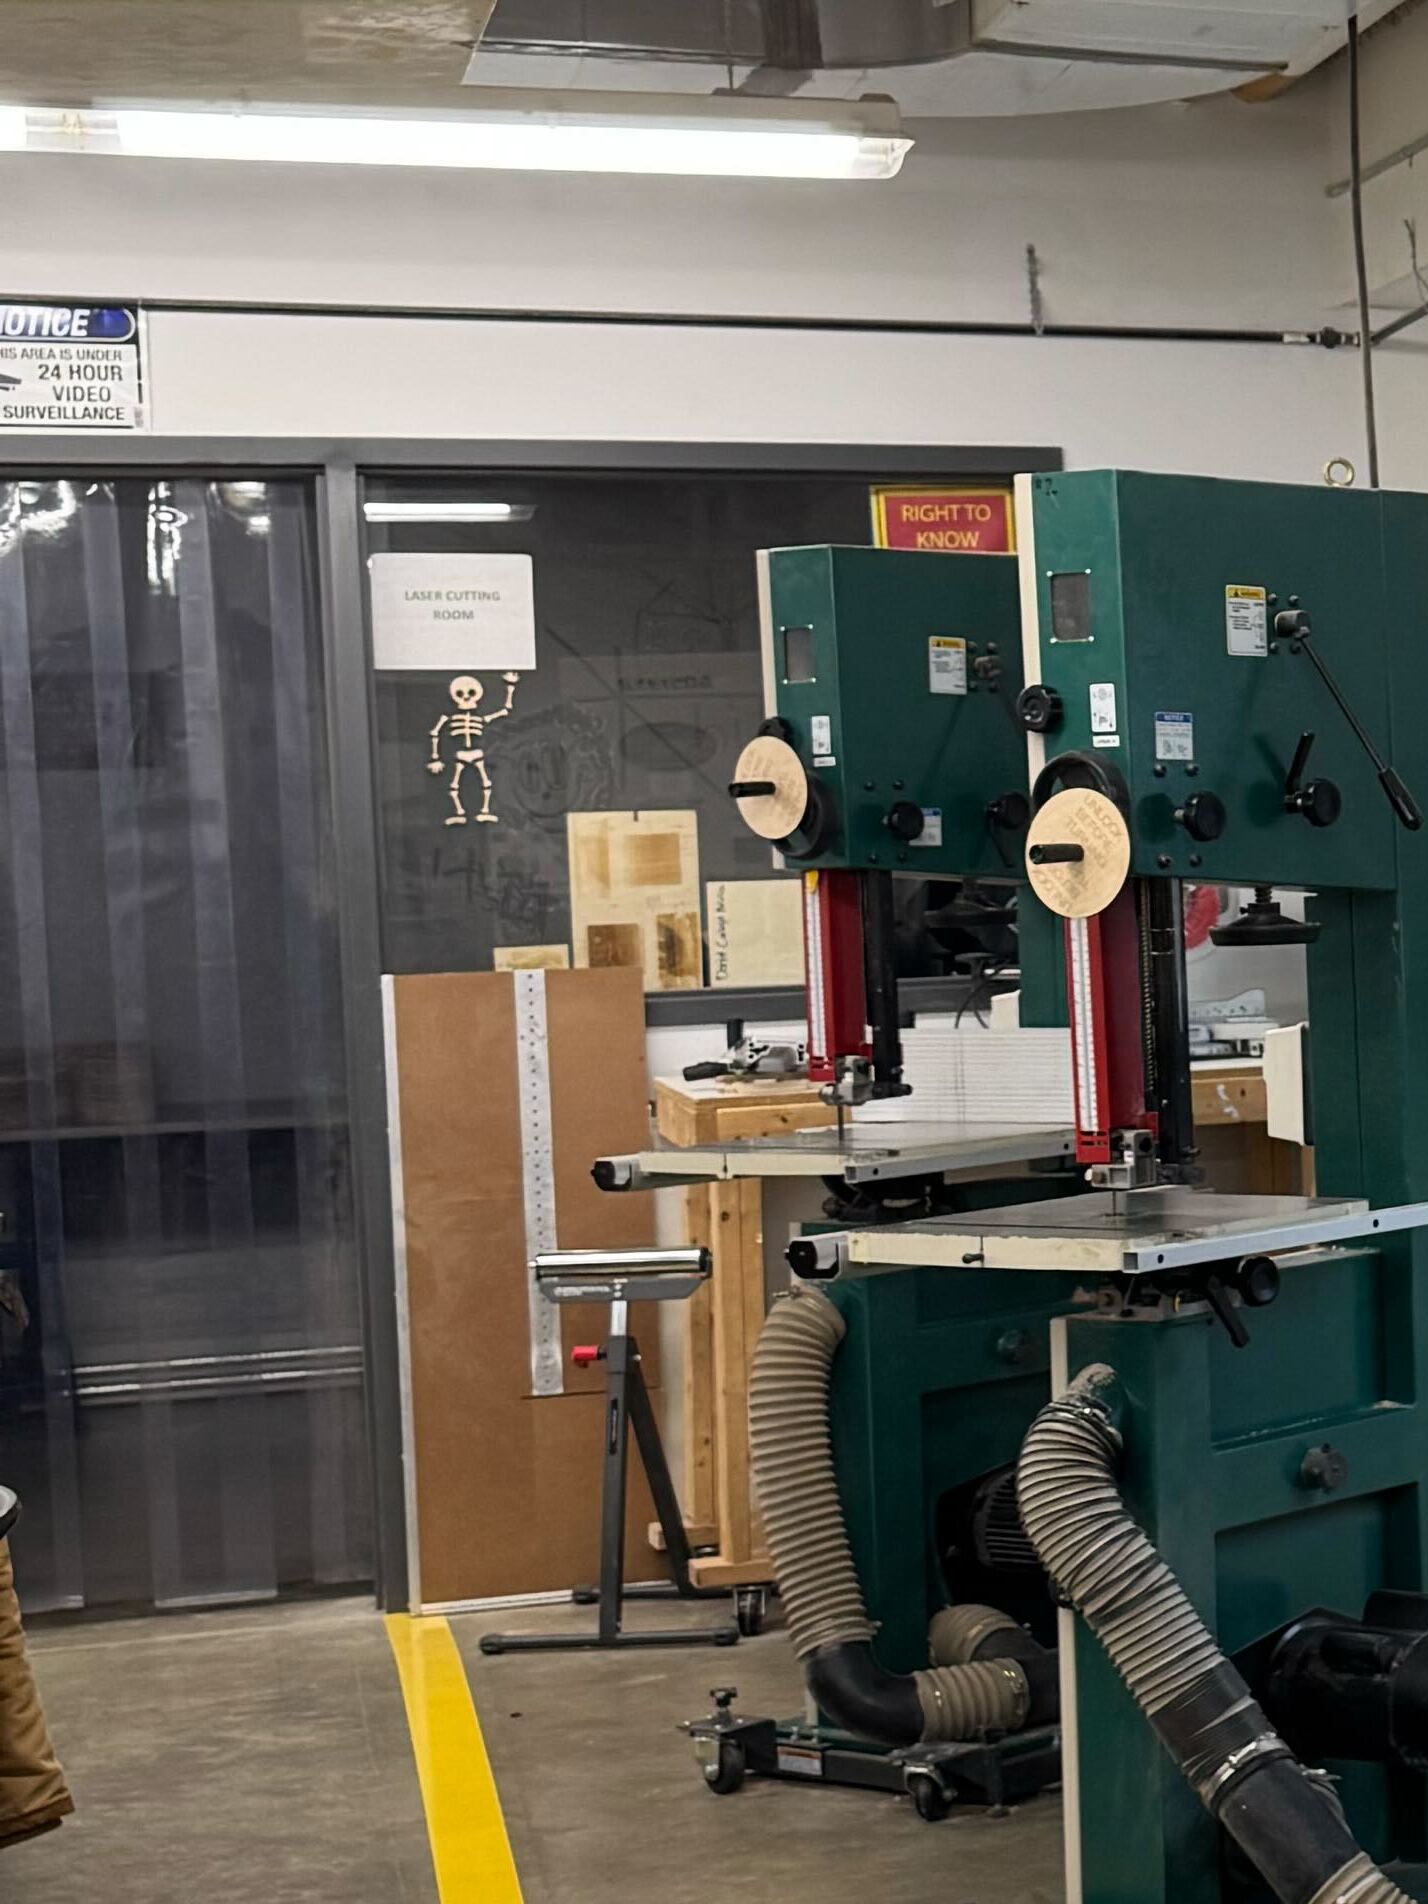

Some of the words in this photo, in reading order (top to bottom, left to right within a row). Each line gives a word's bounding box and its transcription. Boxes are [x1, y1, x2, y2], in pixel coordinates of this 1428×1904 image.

[20, 348, 57, 360] AREA
[60, 348, 73, 361] IS
[76, 348, 123, 362] UNDER
[38, 364, 61, 381] 24
[68, 364, 123, 382] HOUR
[53, 385, 112, 403] VIDEO
[3, 405, 125, 421] SURVEILLANCE
[902, 504, 960, 523] RIGHT
[961, 504, 992, 523] TO
[916, 530, 980, 549] KNOW
[404, 590, 443, 602] LASER
[445, 590, 501, 602] CUTTING
[432, 610, 475, 621] ROOM
